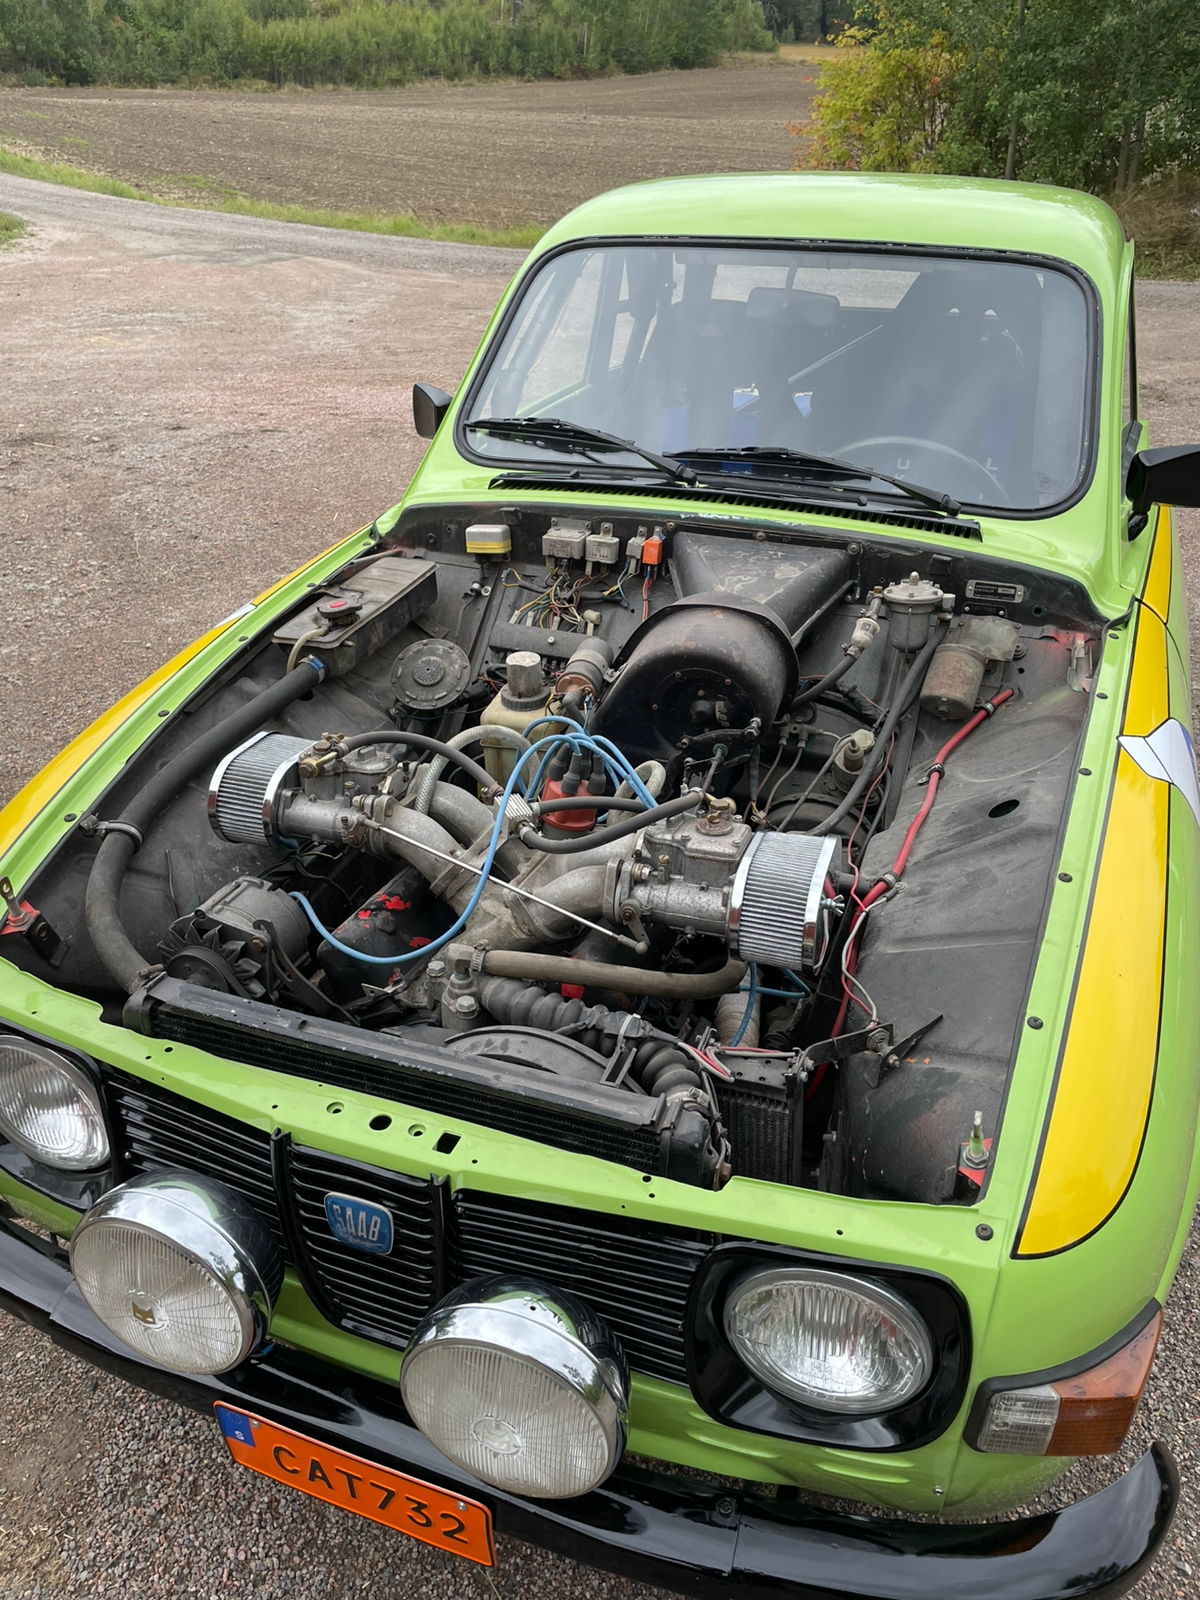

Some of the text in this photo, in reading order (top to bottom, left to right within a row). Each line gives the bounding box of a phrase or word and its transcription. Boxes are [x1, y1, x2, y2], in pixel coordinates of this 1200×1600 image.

[333, 1204, 382, 1241] SAAB
[234, 1430, 245, 1441] S
[272, 1446, 469, 1545] CAT732
